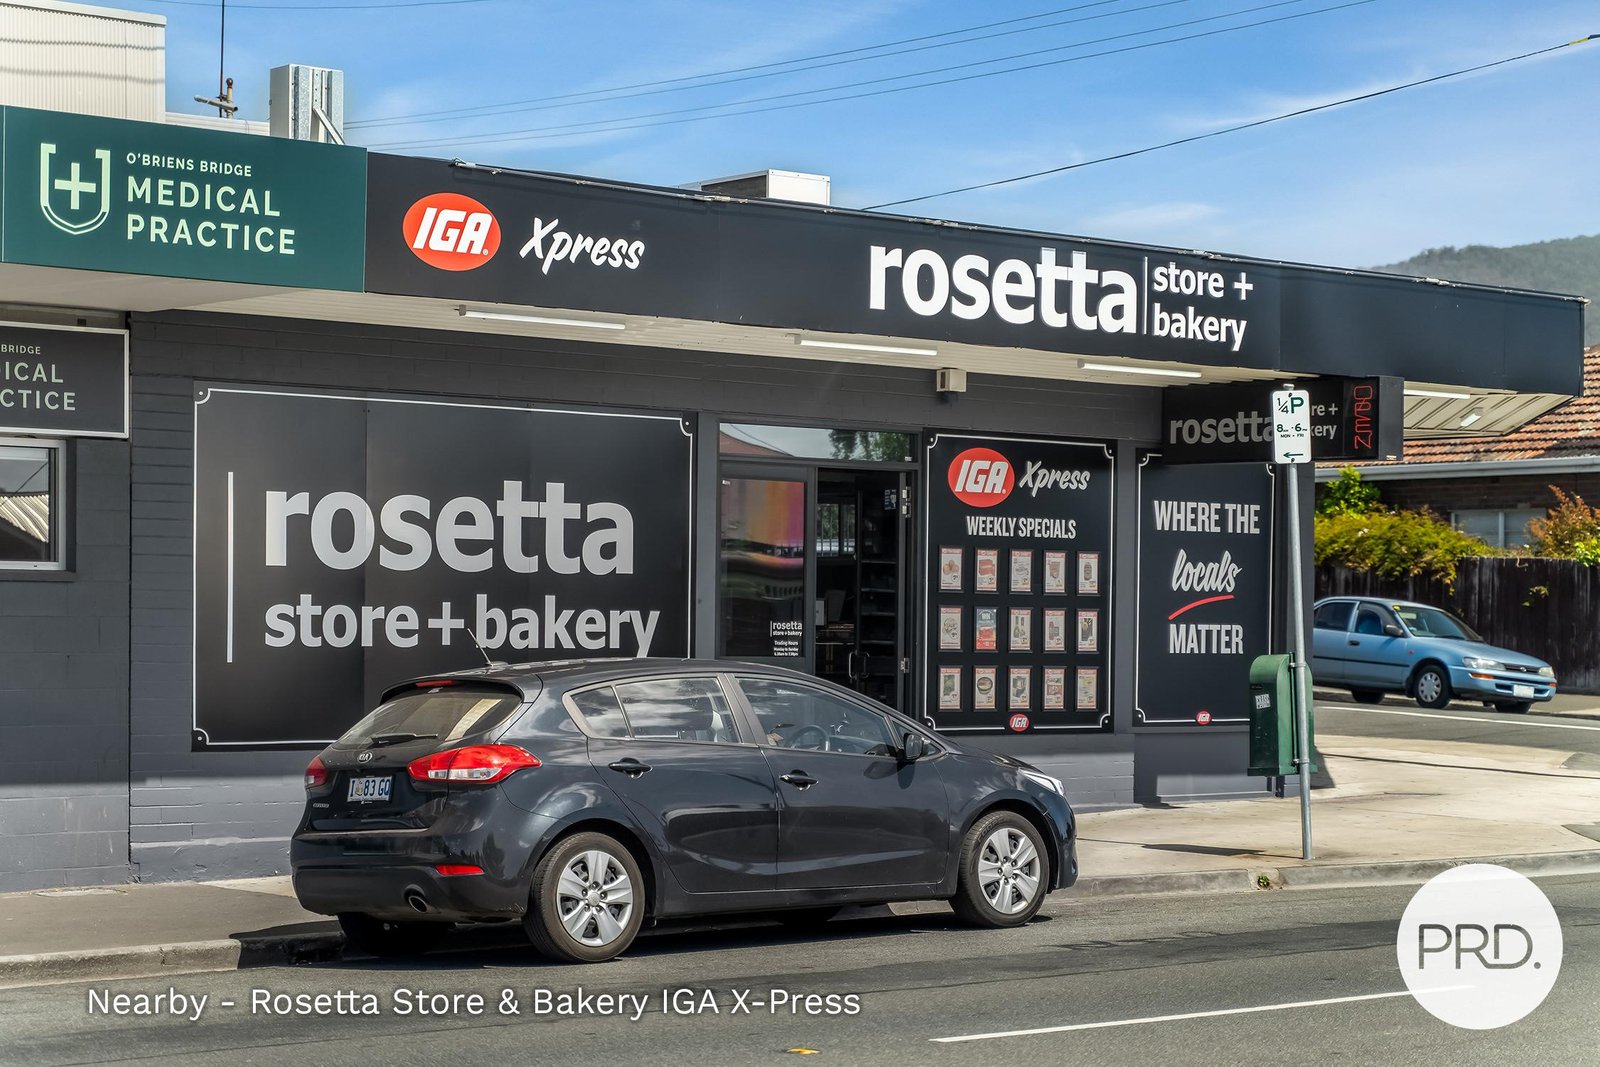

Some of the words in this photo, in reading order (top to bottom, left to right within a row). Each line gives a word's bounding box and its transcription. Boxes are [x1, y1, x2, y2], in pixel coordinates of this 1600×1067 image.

[127, 152, 195, 171] O'BRIENS
[199, 160, 252, 177] BRIDGE
[127, 175, 281, 217] MEDICAL
[127, 213, 296, 255] PRACTICE
[413, 207, 492, 255] IGA
[519, 217, 646, 275] Xpress
[869, 244, 1138, 334] rosetta
[1153, 261, 1224, 298] store
[1234, 271, 1254, 300] +
[1153, 302, 1248, 352] bakery
[1, 344, 41, 355] BRIDGE
[0, 361, 63, 383] ICAL
[954, 459, 1009, 493] IGA
[1018, 460, 1091, 497] Xpress
[265, 480, 634, 576] rosetta
[966, 515, 1017, 537] WEEKLY
[1018, 517, 1077, 540] SPECIALS
[1153, 500, 1221, 533] WHERE
[1225, 503, 1261, 534] THE
[1171, 548, 1243, 593] locals
[773, 621, 802, 629] rosetta
[1169, 623, 1244, 654] MATTER
[1011, 716, 1029, 728] IGA
[364, 780, 376, 796] 83
